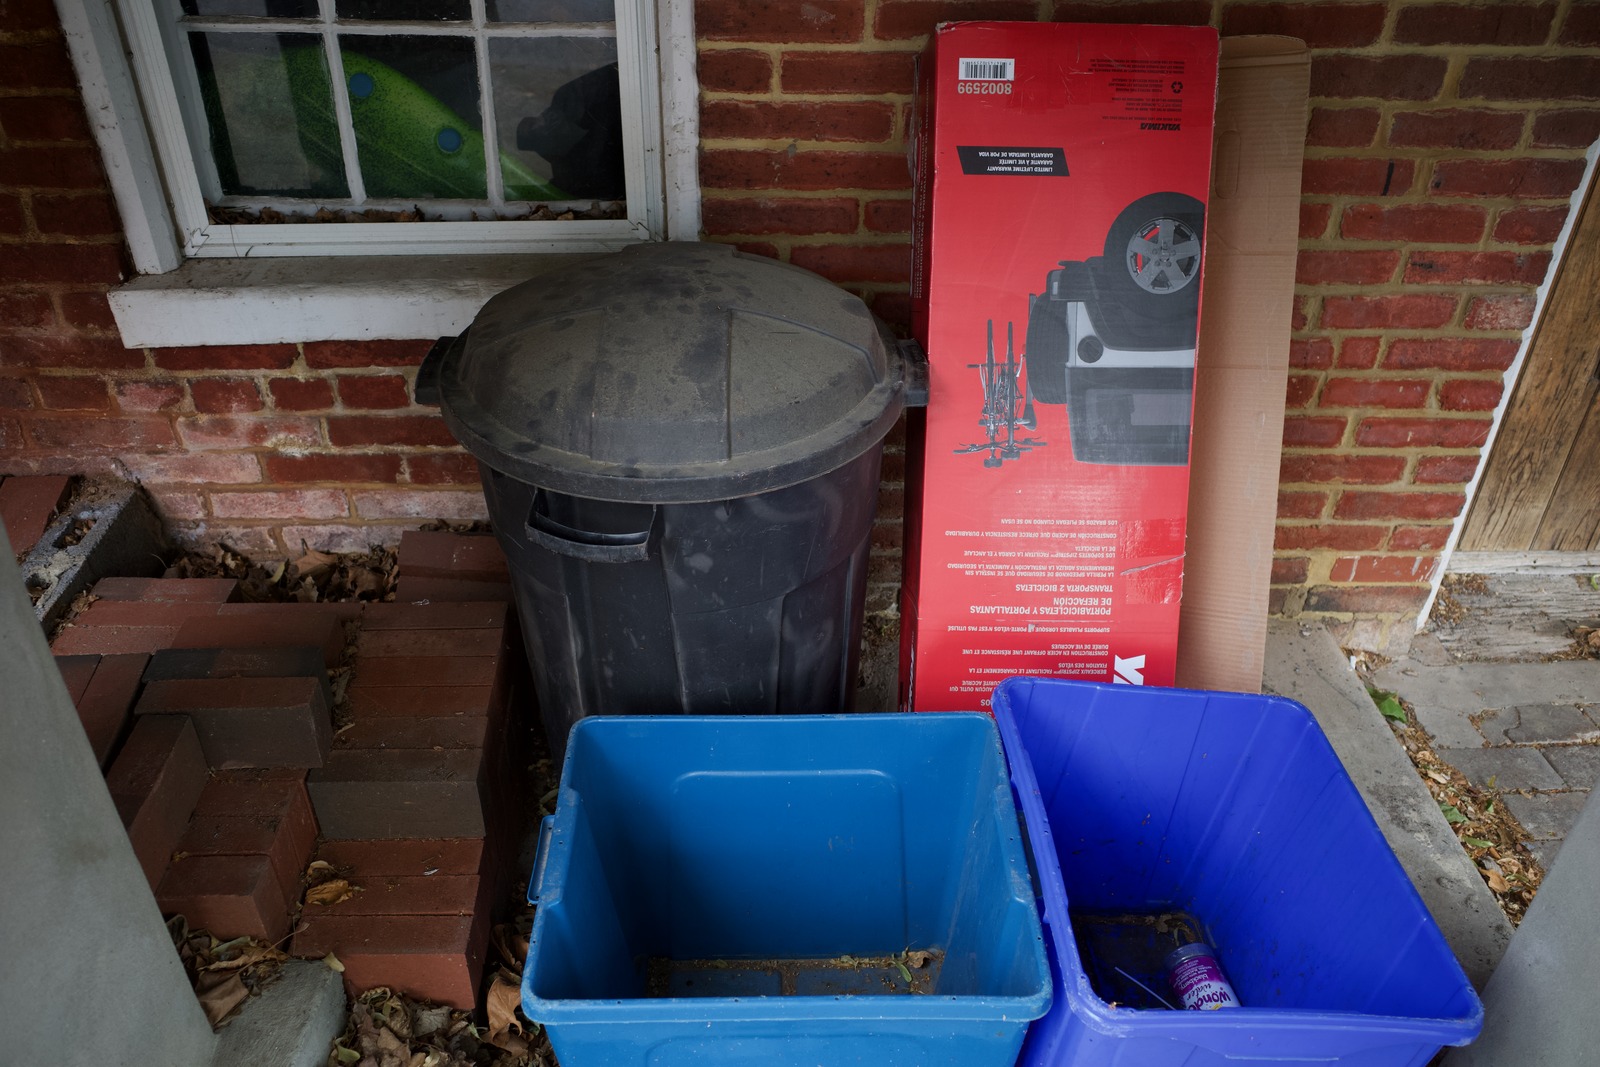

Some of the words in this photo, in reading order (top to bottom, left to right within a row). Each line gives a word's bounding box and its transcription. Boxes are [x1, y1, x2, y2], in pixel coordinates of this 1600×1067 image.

[958, 81, 1012, 95] 8002599
[1140, 123, 1181, 131] YAKIMA
[1016, 583, 1057, 592] BICICLETAS
[1067, 584, 1113, 593] TRANSPORTA
[1054, 596, 1098, 606] REFACCIÓN
[1101, 597, 1111, 606] DE
[970, 605, 1030, 614] PORTALLANTAS
[1040, 606, 1111, 615] PORTABICICLETAS
